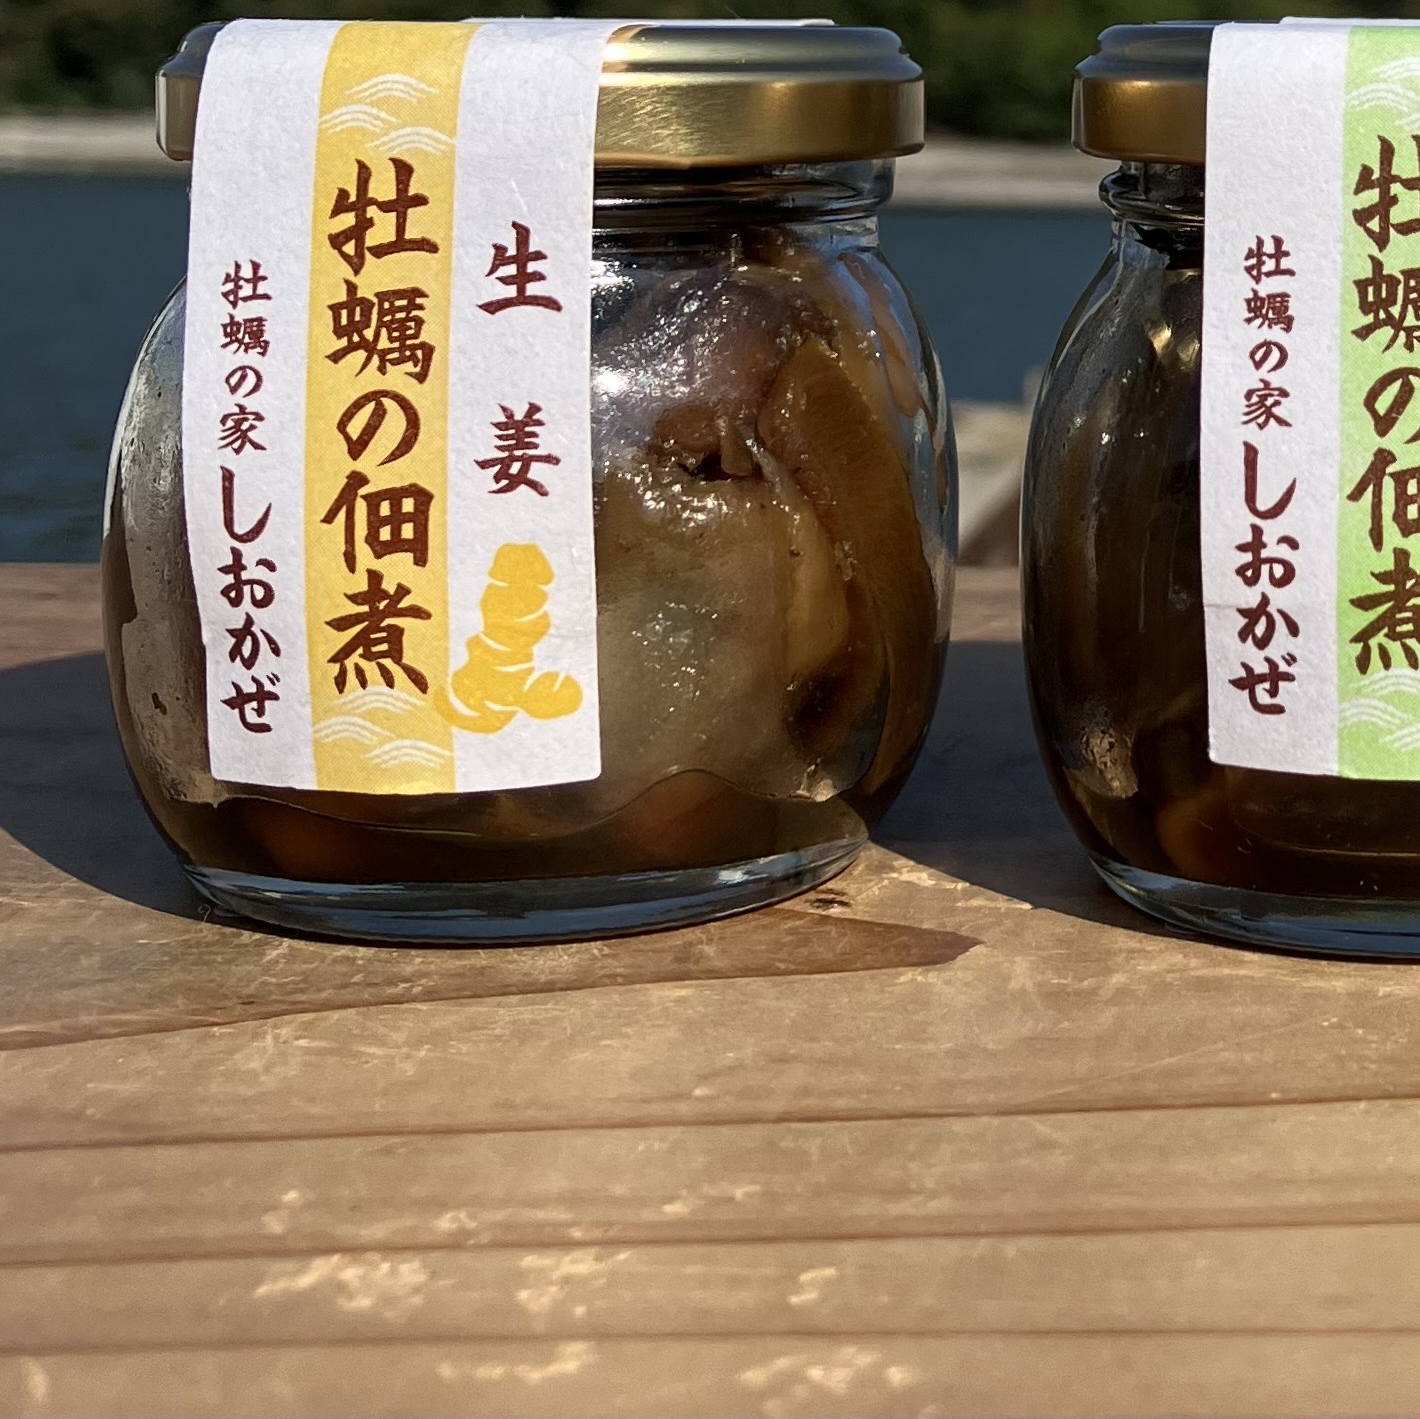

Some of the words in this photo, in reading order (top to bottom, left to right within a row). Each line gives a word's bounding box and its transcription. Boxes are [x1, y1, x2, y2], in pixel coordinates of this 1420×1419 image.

[321, 158, 439, 694] 牡蠣の佃煮
[474, 221, 562, 496] 生姜
